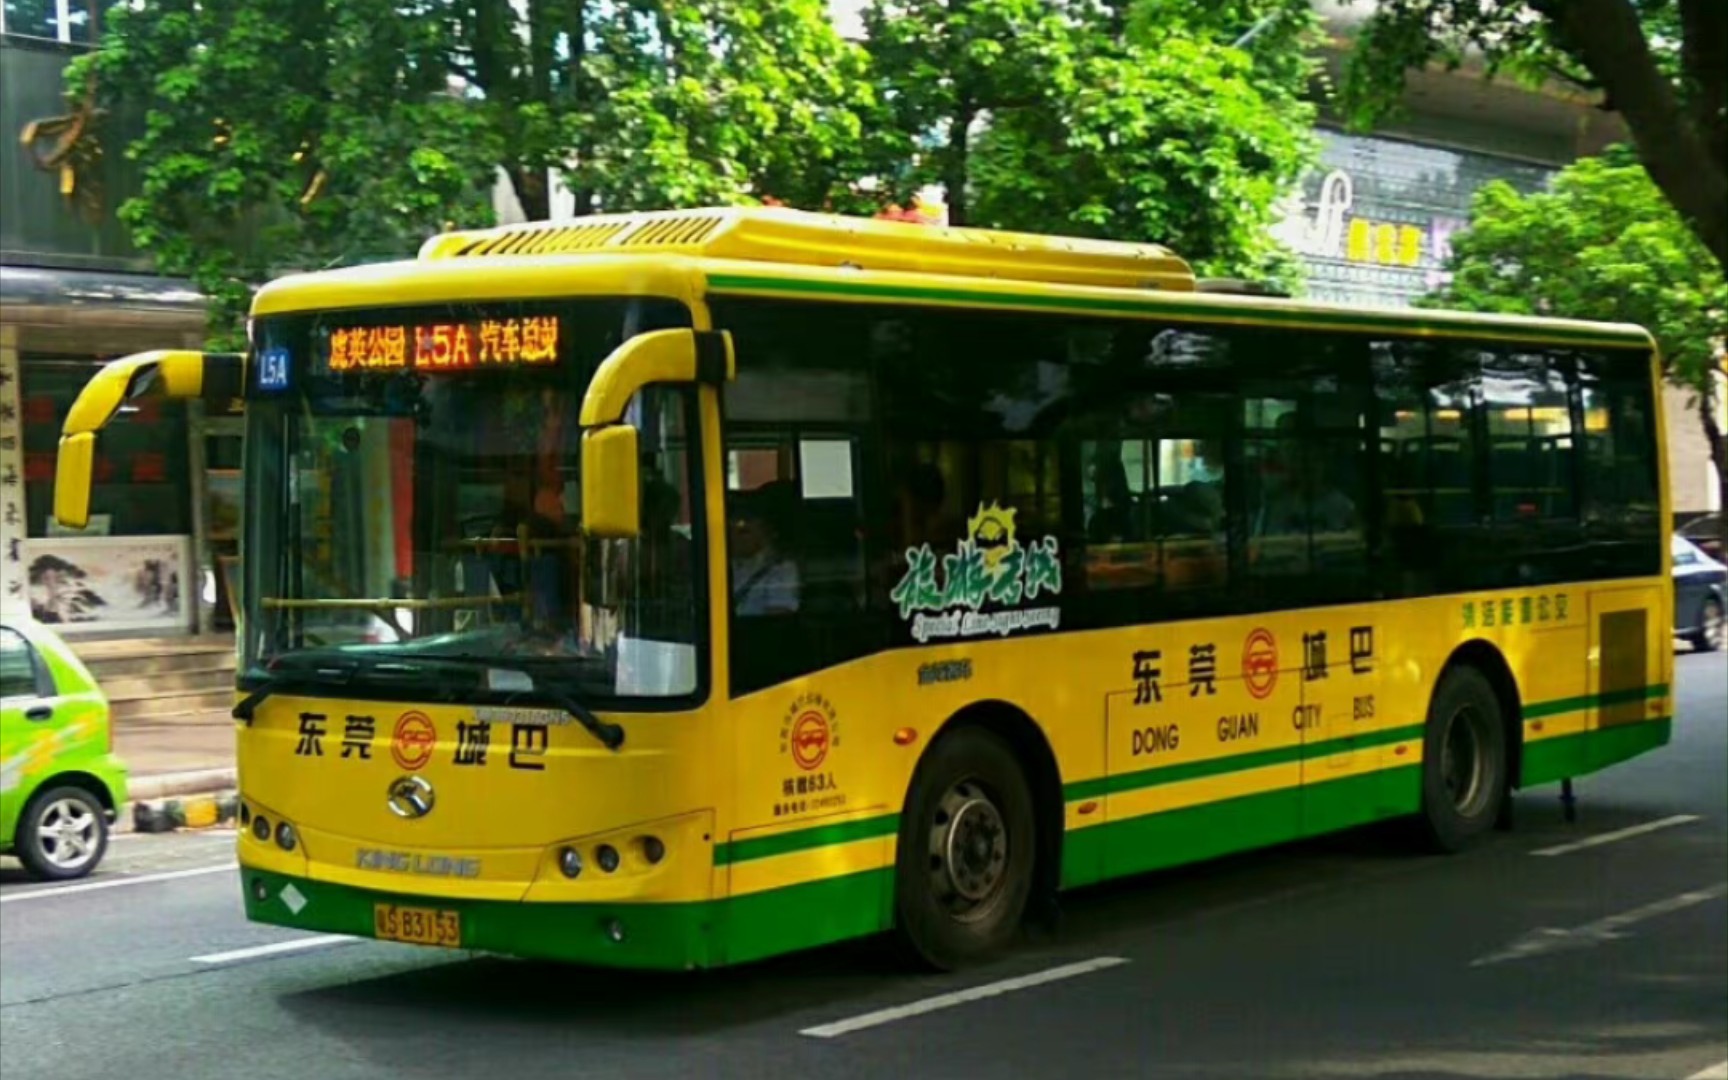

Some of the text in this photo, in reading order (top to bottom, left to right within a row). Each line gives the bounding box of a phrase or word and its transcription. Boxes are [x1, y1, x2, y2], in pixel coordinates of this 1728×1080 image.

[260, 353, 287, 385] L5A
[415, 325, 470, 366] L5A
[1132, 626, 1374, 705] 东莞 城巴
[295, 711, 549, 770] 东莞 城巴
[1132, 695, 1374, 756] DONG GUAN CITY BUS
[356, 847, 482, 879] KING LONG
